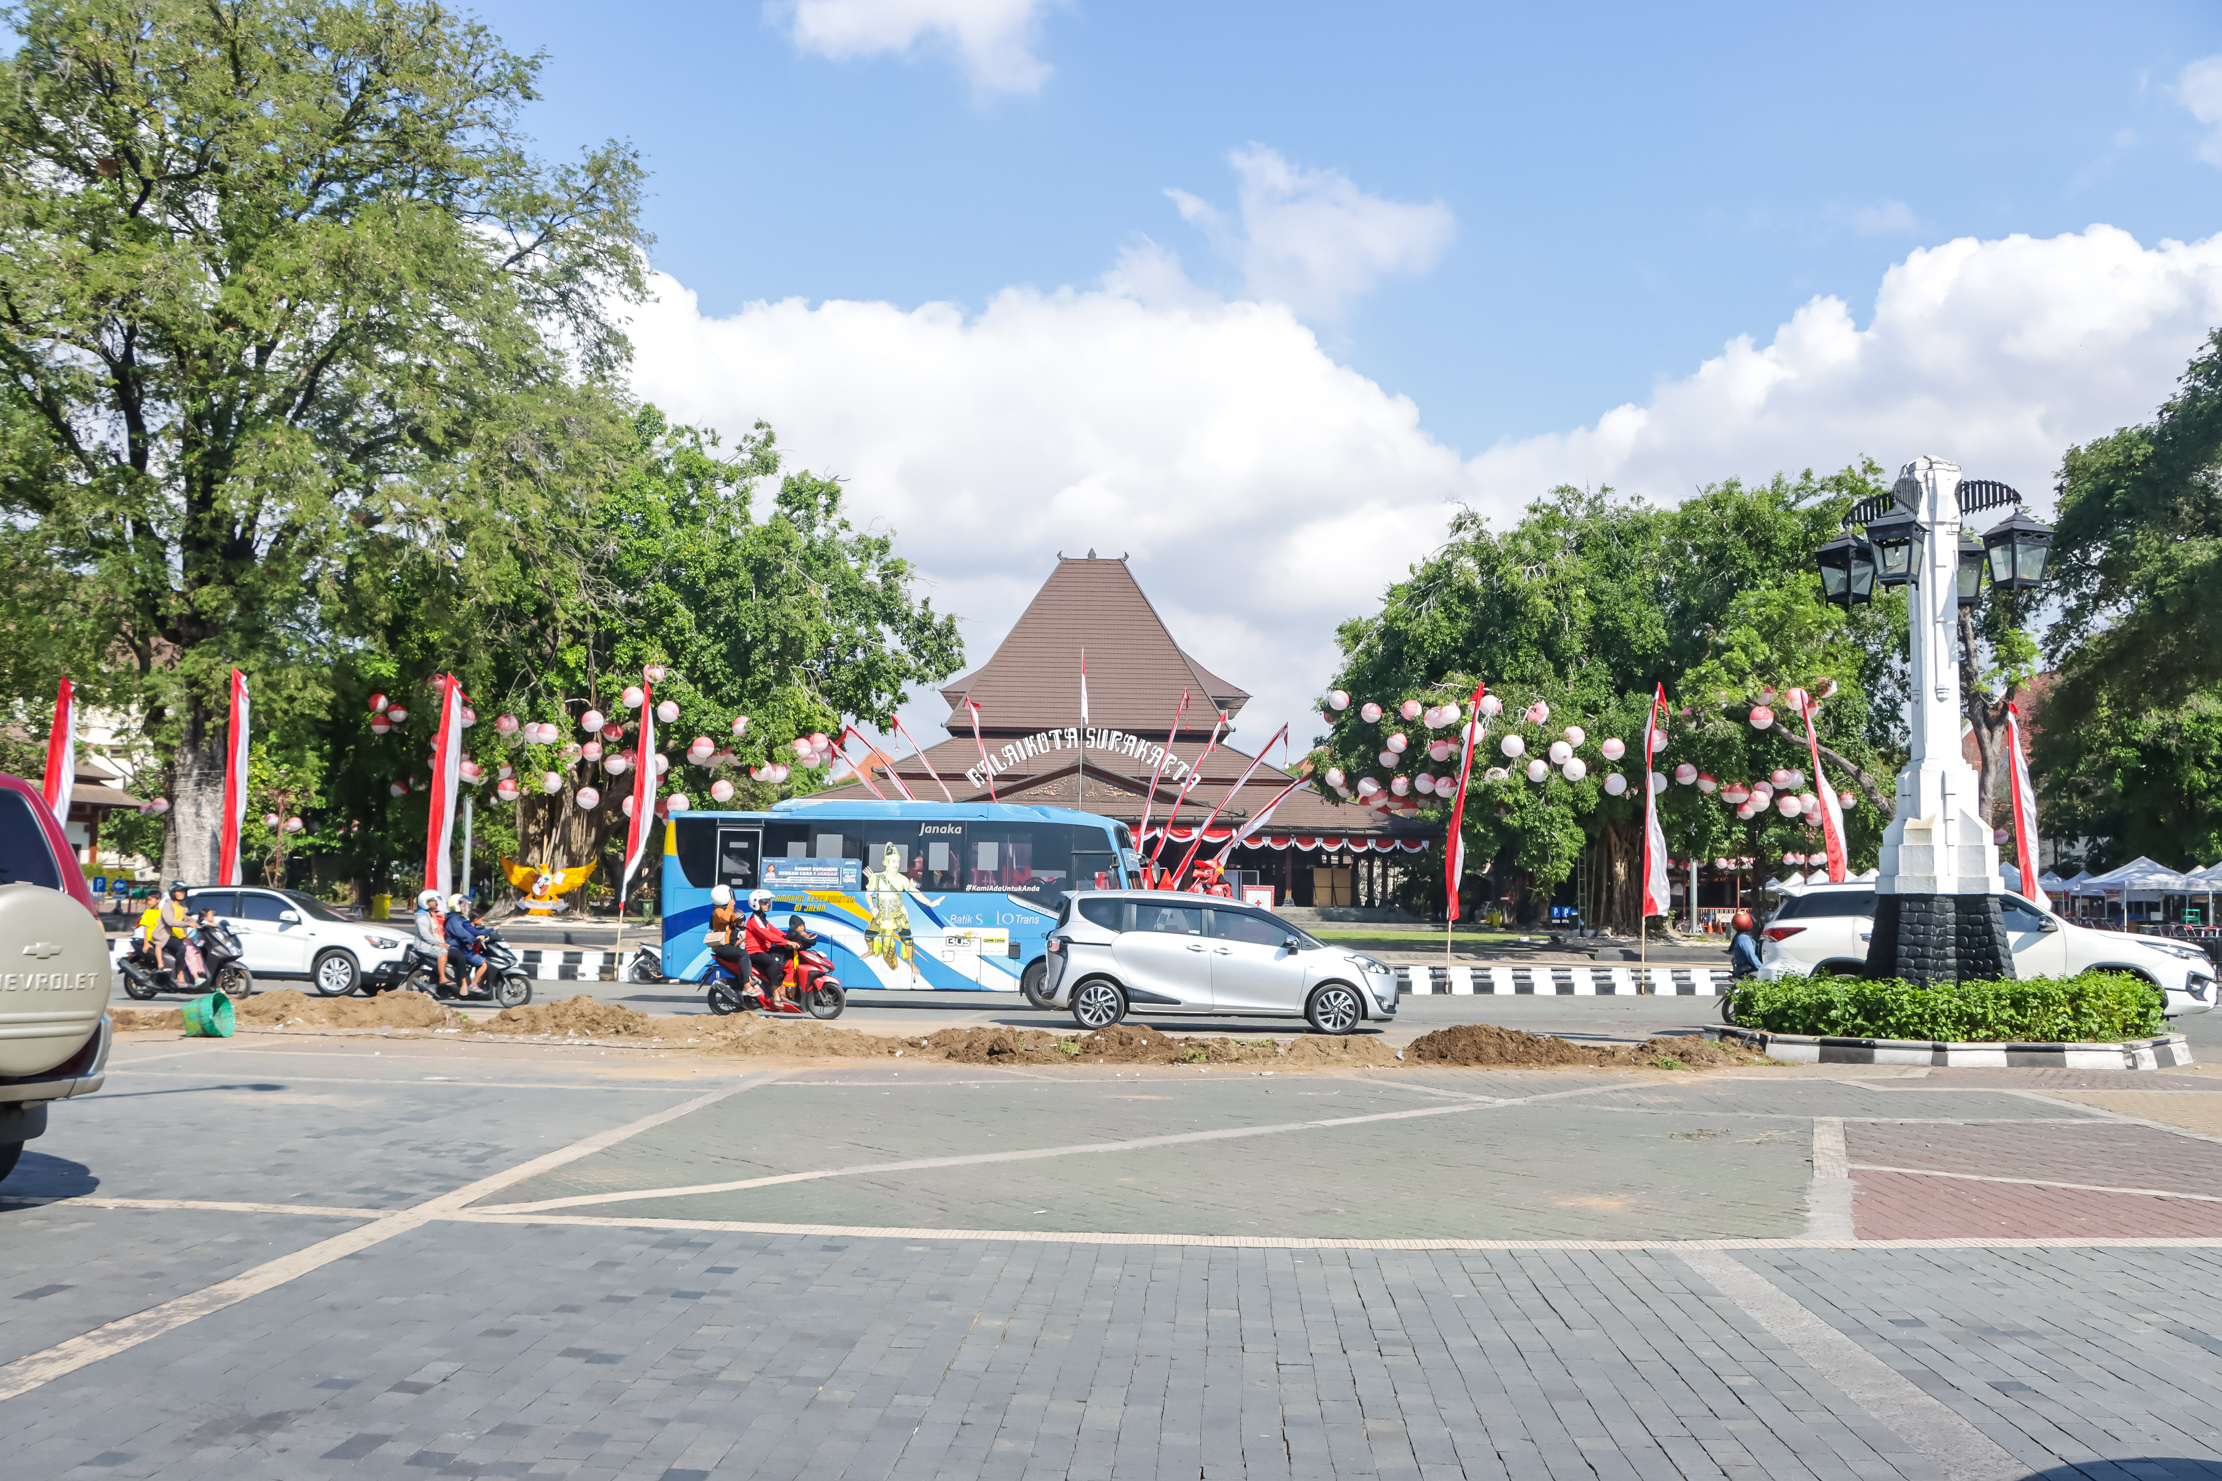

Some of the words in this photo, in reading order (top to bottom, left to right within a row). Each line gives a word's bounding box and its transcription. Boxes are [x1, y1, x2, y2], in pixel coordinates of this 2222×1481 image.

[964, 727, 1079, 789] BALAIKOTA
[1085, 727, 1202, 793] SURAKARTA
[918, 822, 962, 837] Janaka
[965, 884, 1040, 892] #KamiAdaUntukAnda
[774, 894, 804, 903] AMAKAN
[804, 903, 826, 912] JALAN
[950, 914, 973, 925] Batik
[1016, 914, 1040, 925] Trans
[0, 972, 99, 992] EVROLET
